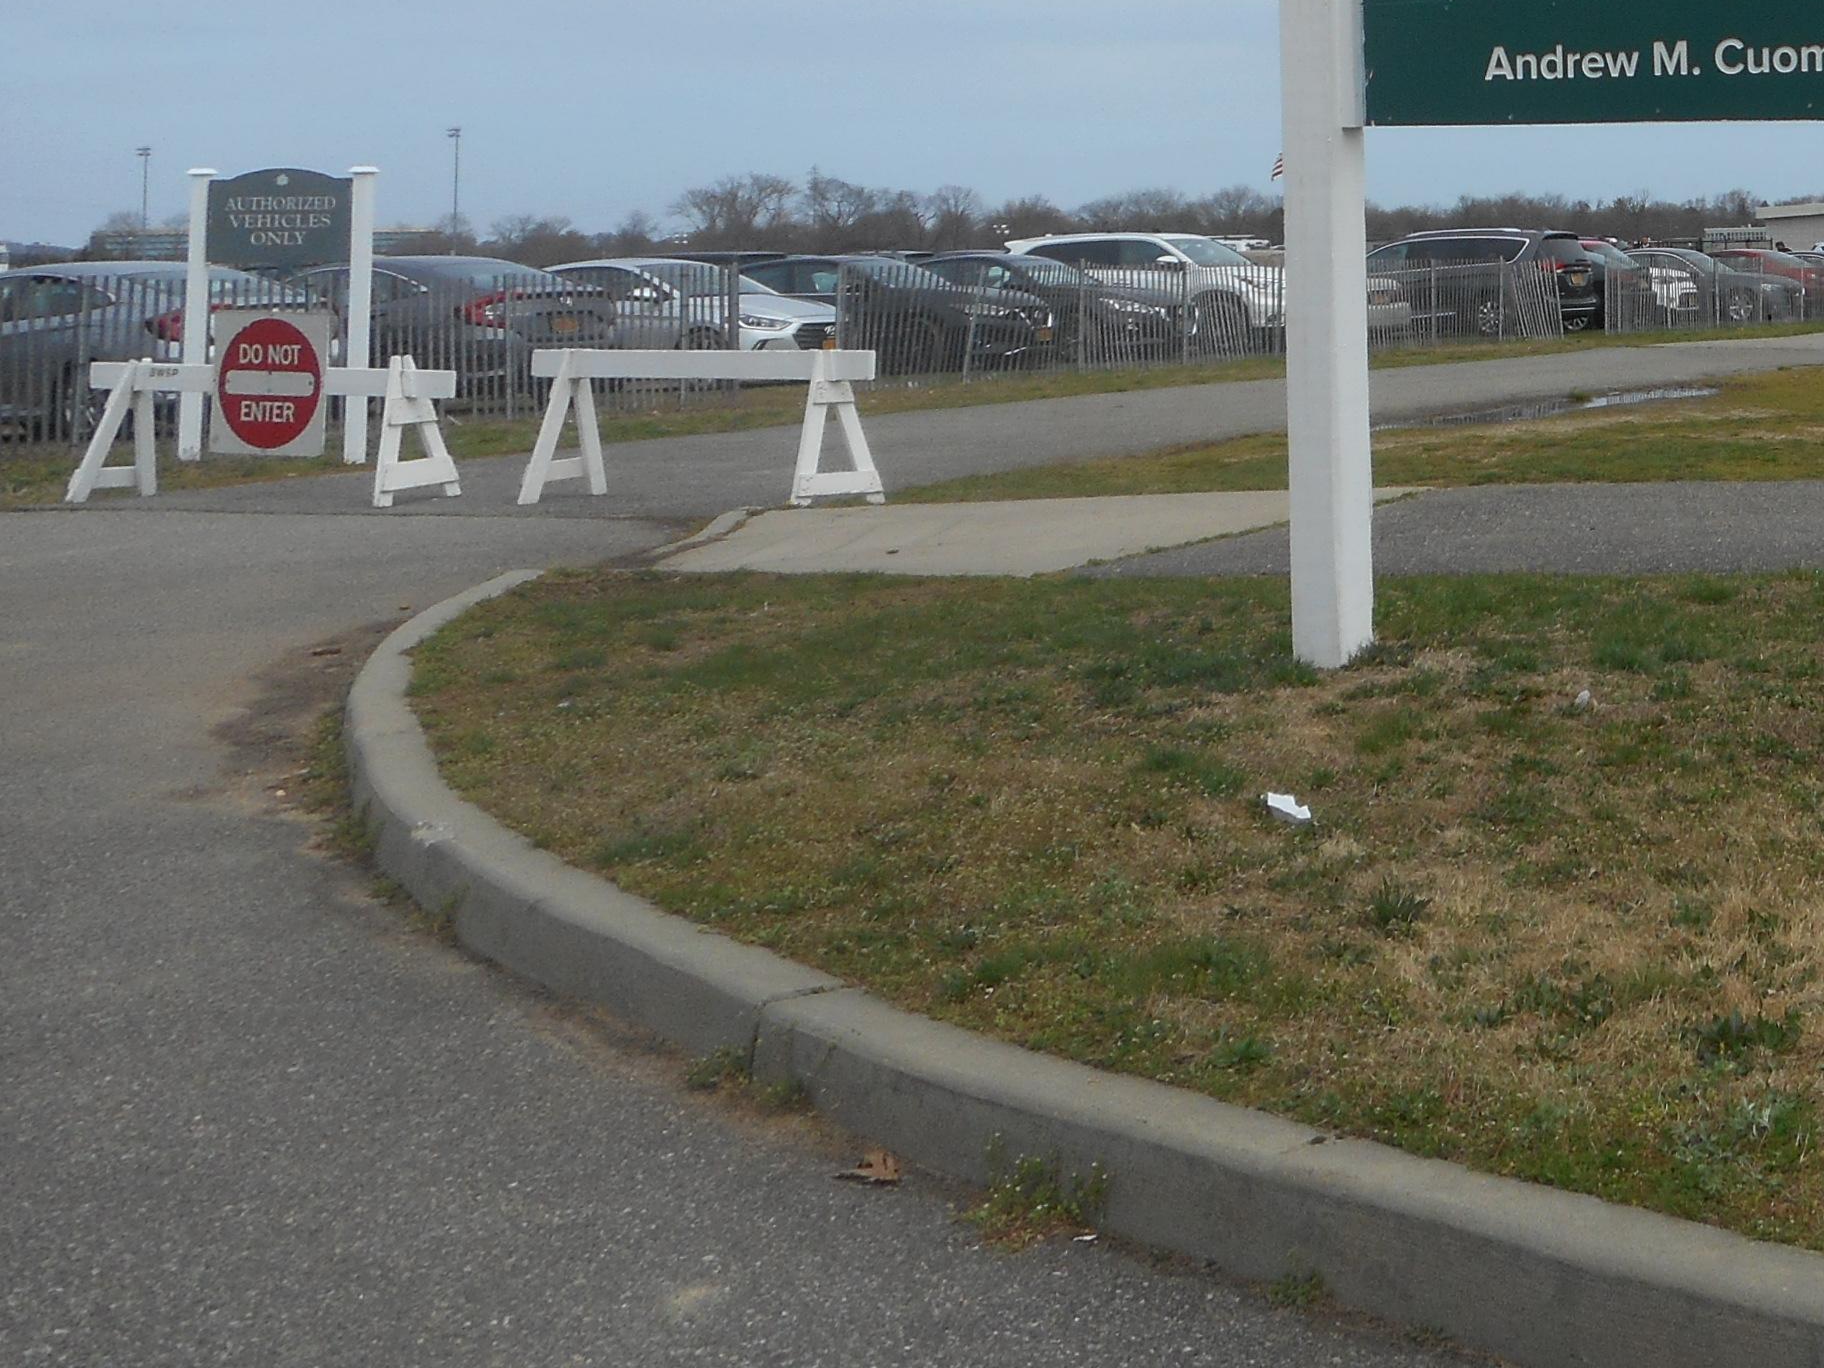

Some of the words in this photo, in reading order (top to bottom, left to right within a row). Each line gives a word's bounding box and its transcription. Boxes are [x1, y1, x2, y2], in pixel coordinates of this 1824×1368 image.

[1485, 44, 1639, 81] Andrew
[1653, 40, 1703, 76] M.
[224, 196, 336, 211] AUTHORIZED
[229, 213, 332, 228] VEHICLES
[250, 231, 306, 245] ONLY
[239, 343, 262, 365] DO
[268, 344, 301, 365] NOT
[240, 401, 294, 423] ENTER
